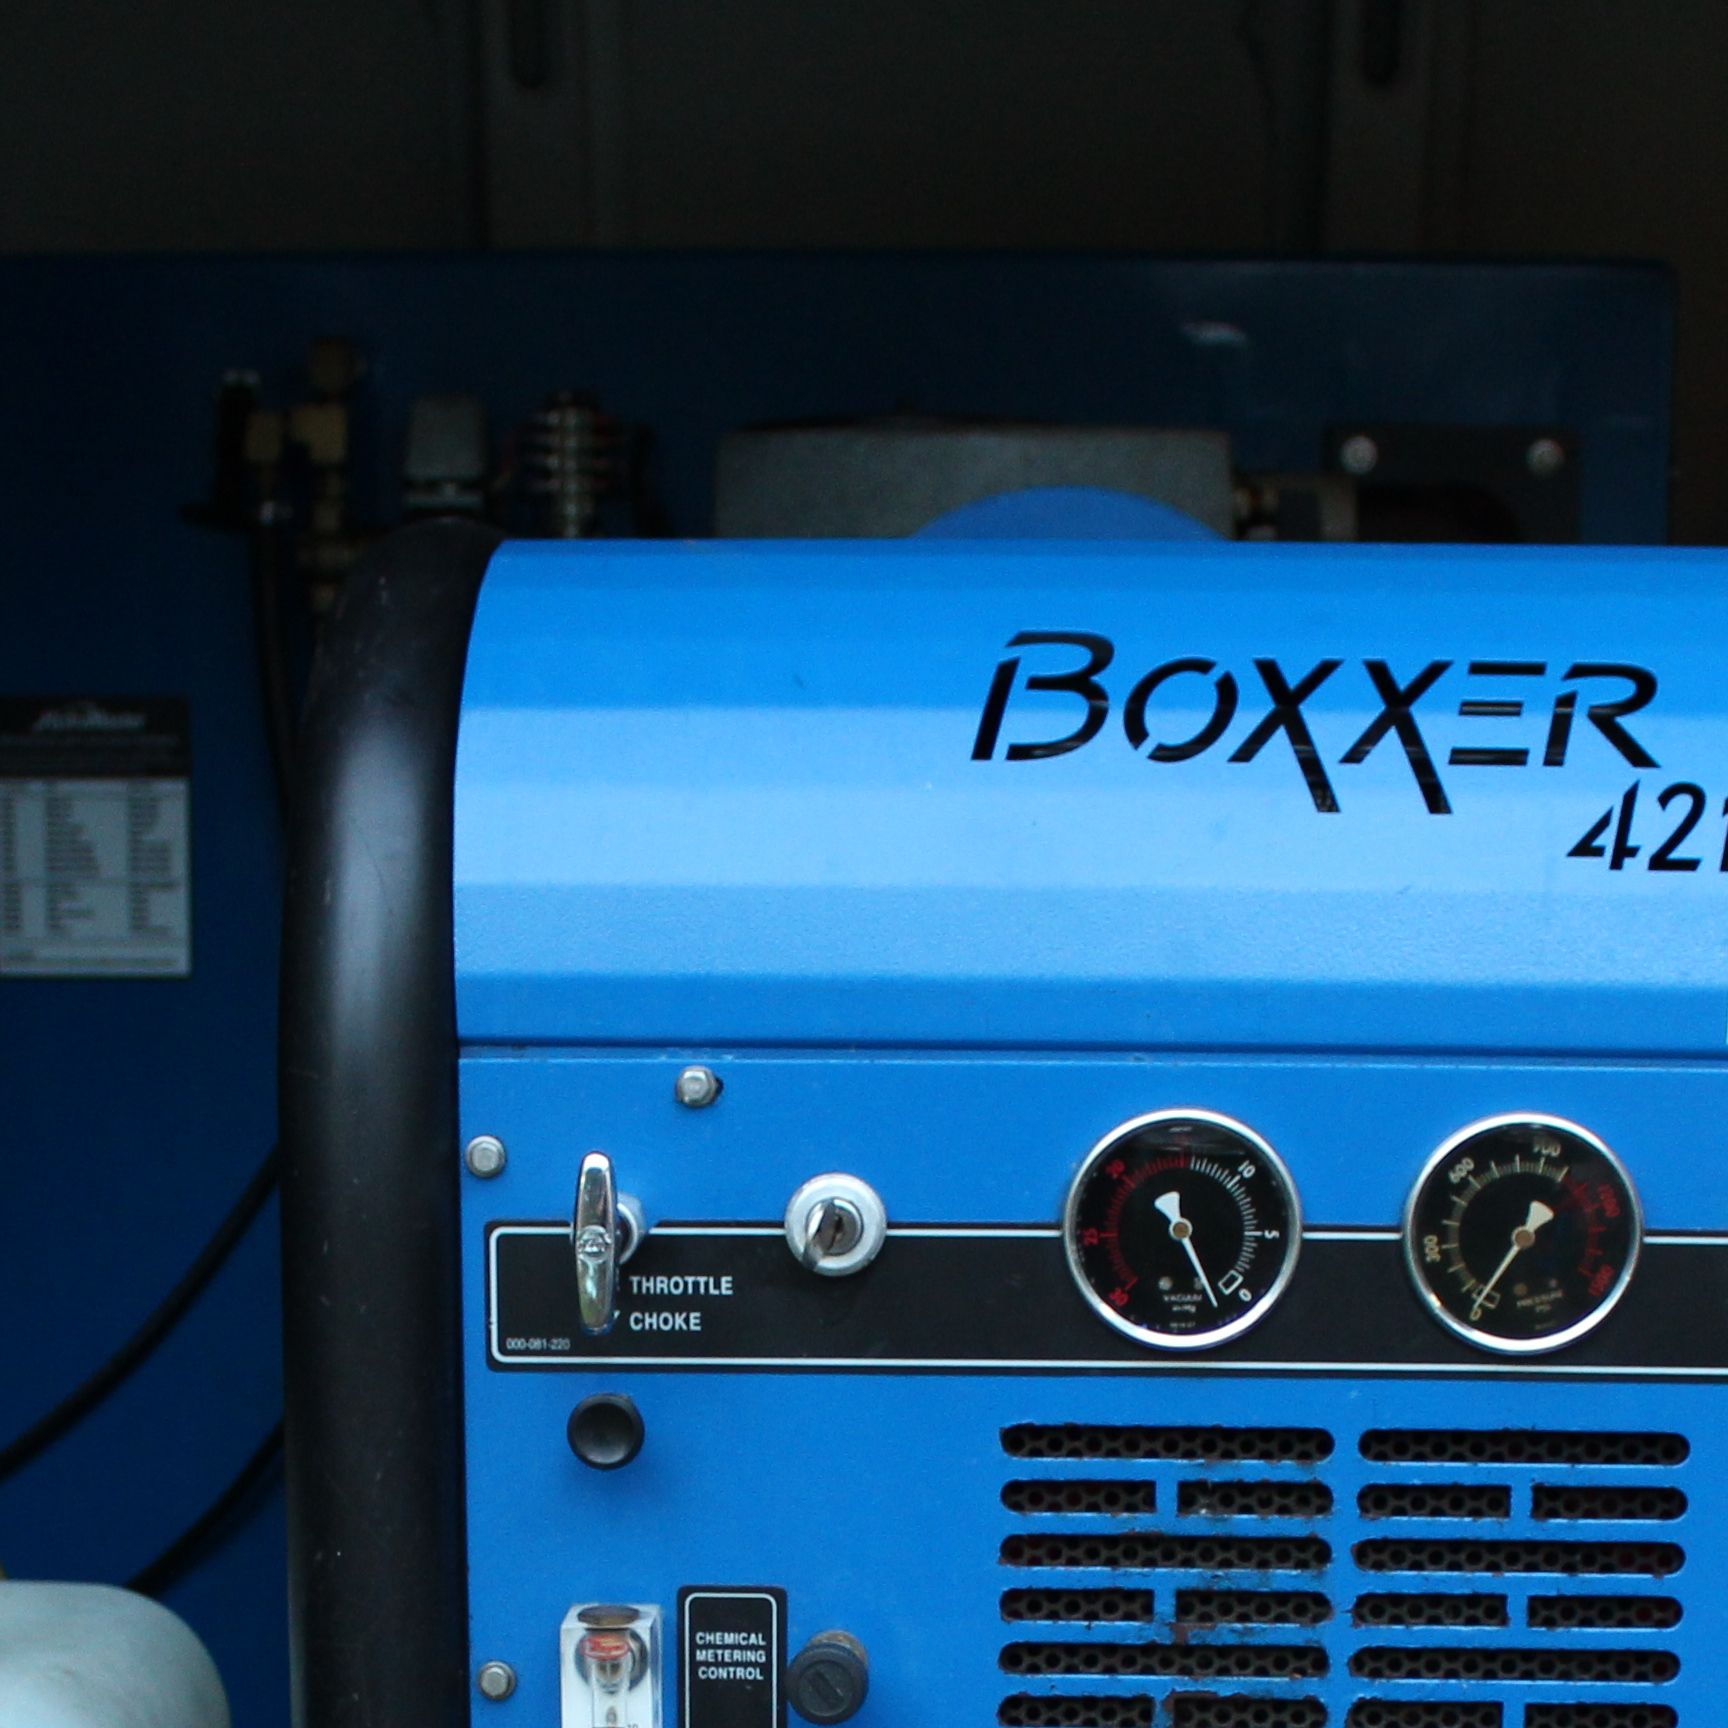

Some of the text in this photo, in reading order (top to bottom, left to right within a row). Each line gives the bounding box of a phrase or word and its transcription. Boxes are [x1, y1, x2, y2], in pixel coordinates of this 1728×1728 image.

[971, 630, 1661, 814] BOXXER
[1237, 1160, 1256, 1179] 10
[1264, 1230, 1280, 1239] 5
[1423, 1234, 1442, 1264] 300
[630, 1276, 733, 1296] THROTTLE
[1238, 1290, 1252, 1301] 0
[630, 1312, 701, 1331] CHOKE
[696, 1631, 766, 1646] CHEMICAL
[696, 1649, 766, 1664] METERING
[698, 1666, 764, 1681] CONTROL
